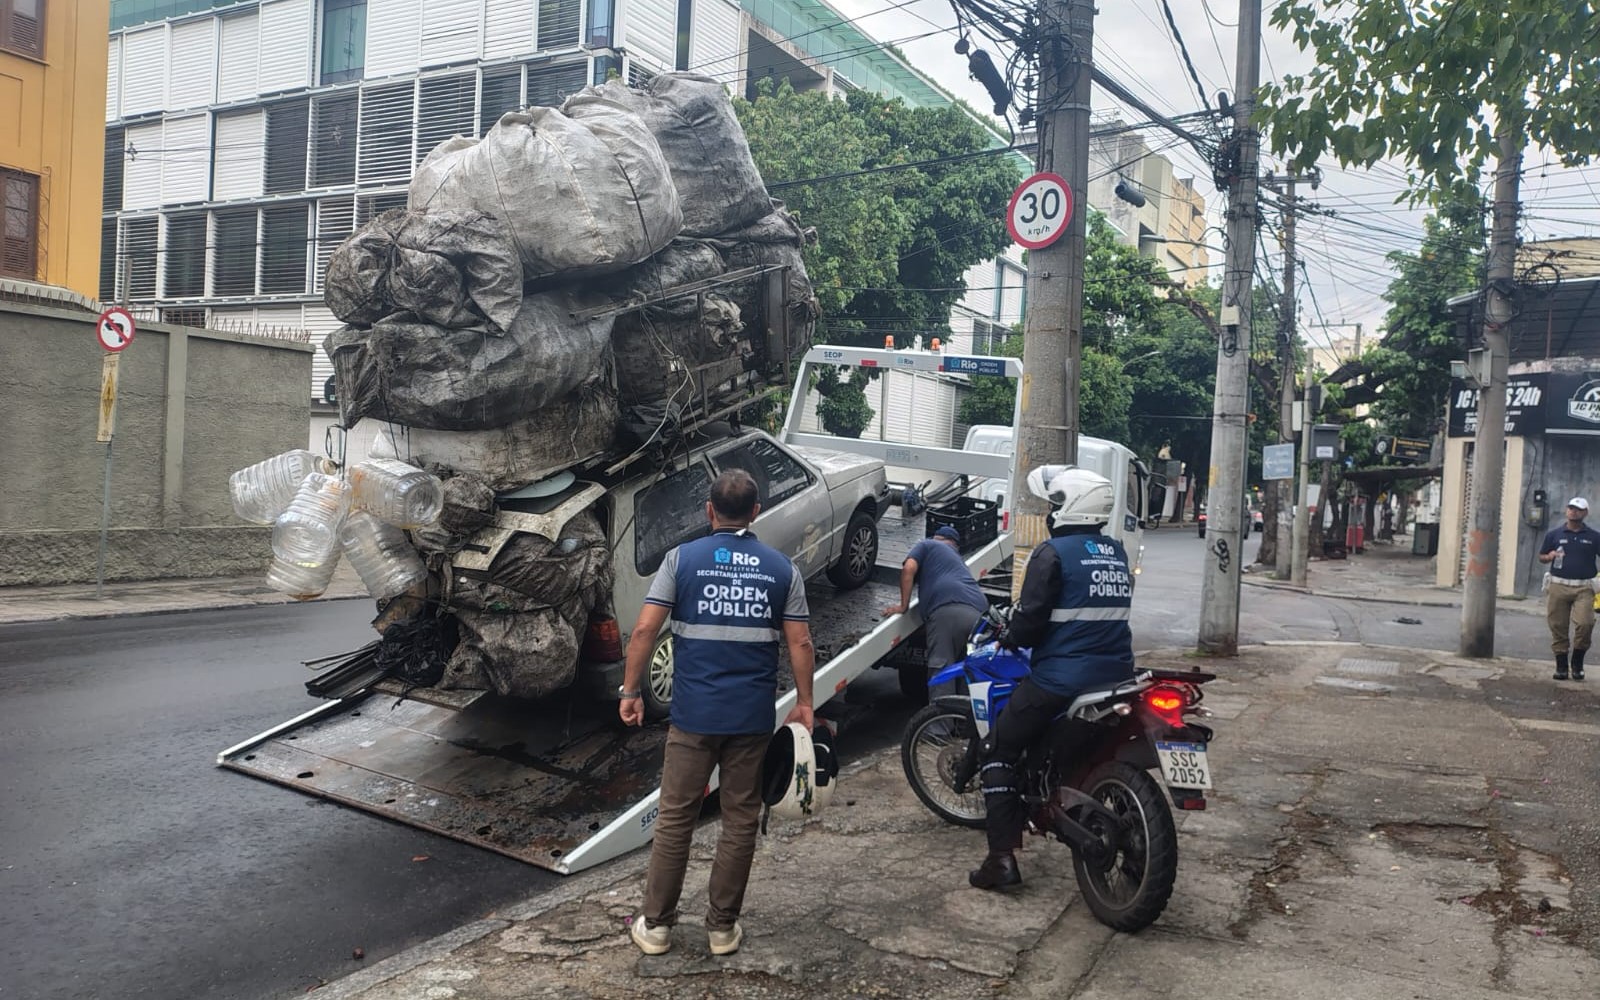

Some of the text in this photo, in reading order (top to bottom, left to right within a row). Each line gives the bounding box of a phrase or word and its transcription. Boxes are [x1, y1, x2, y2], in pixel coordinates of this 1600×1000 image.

[1020, 188, 1060, 223] 30
[1028, 225, 1051, 236] km/h
[961, 359, 978, 369] Rio
[1512, 387, 1541, 407] 24h
[1097, 543, 1115, 555] Rio
[732, 552, 760, 566] Rio
[697, 570, 776, 583] SECRETARIA MUNICIPAL
[1091, 570, 1129, 584] ORDEM
[703, 584, 769, 603] ORDEM
[698, 598, 772, 619] PÚBLICA
[1170, 751, 1198, 768] SSC
[1170, 767, 1206, 785] 2D52
[641, 807, 659, 827] SEO
